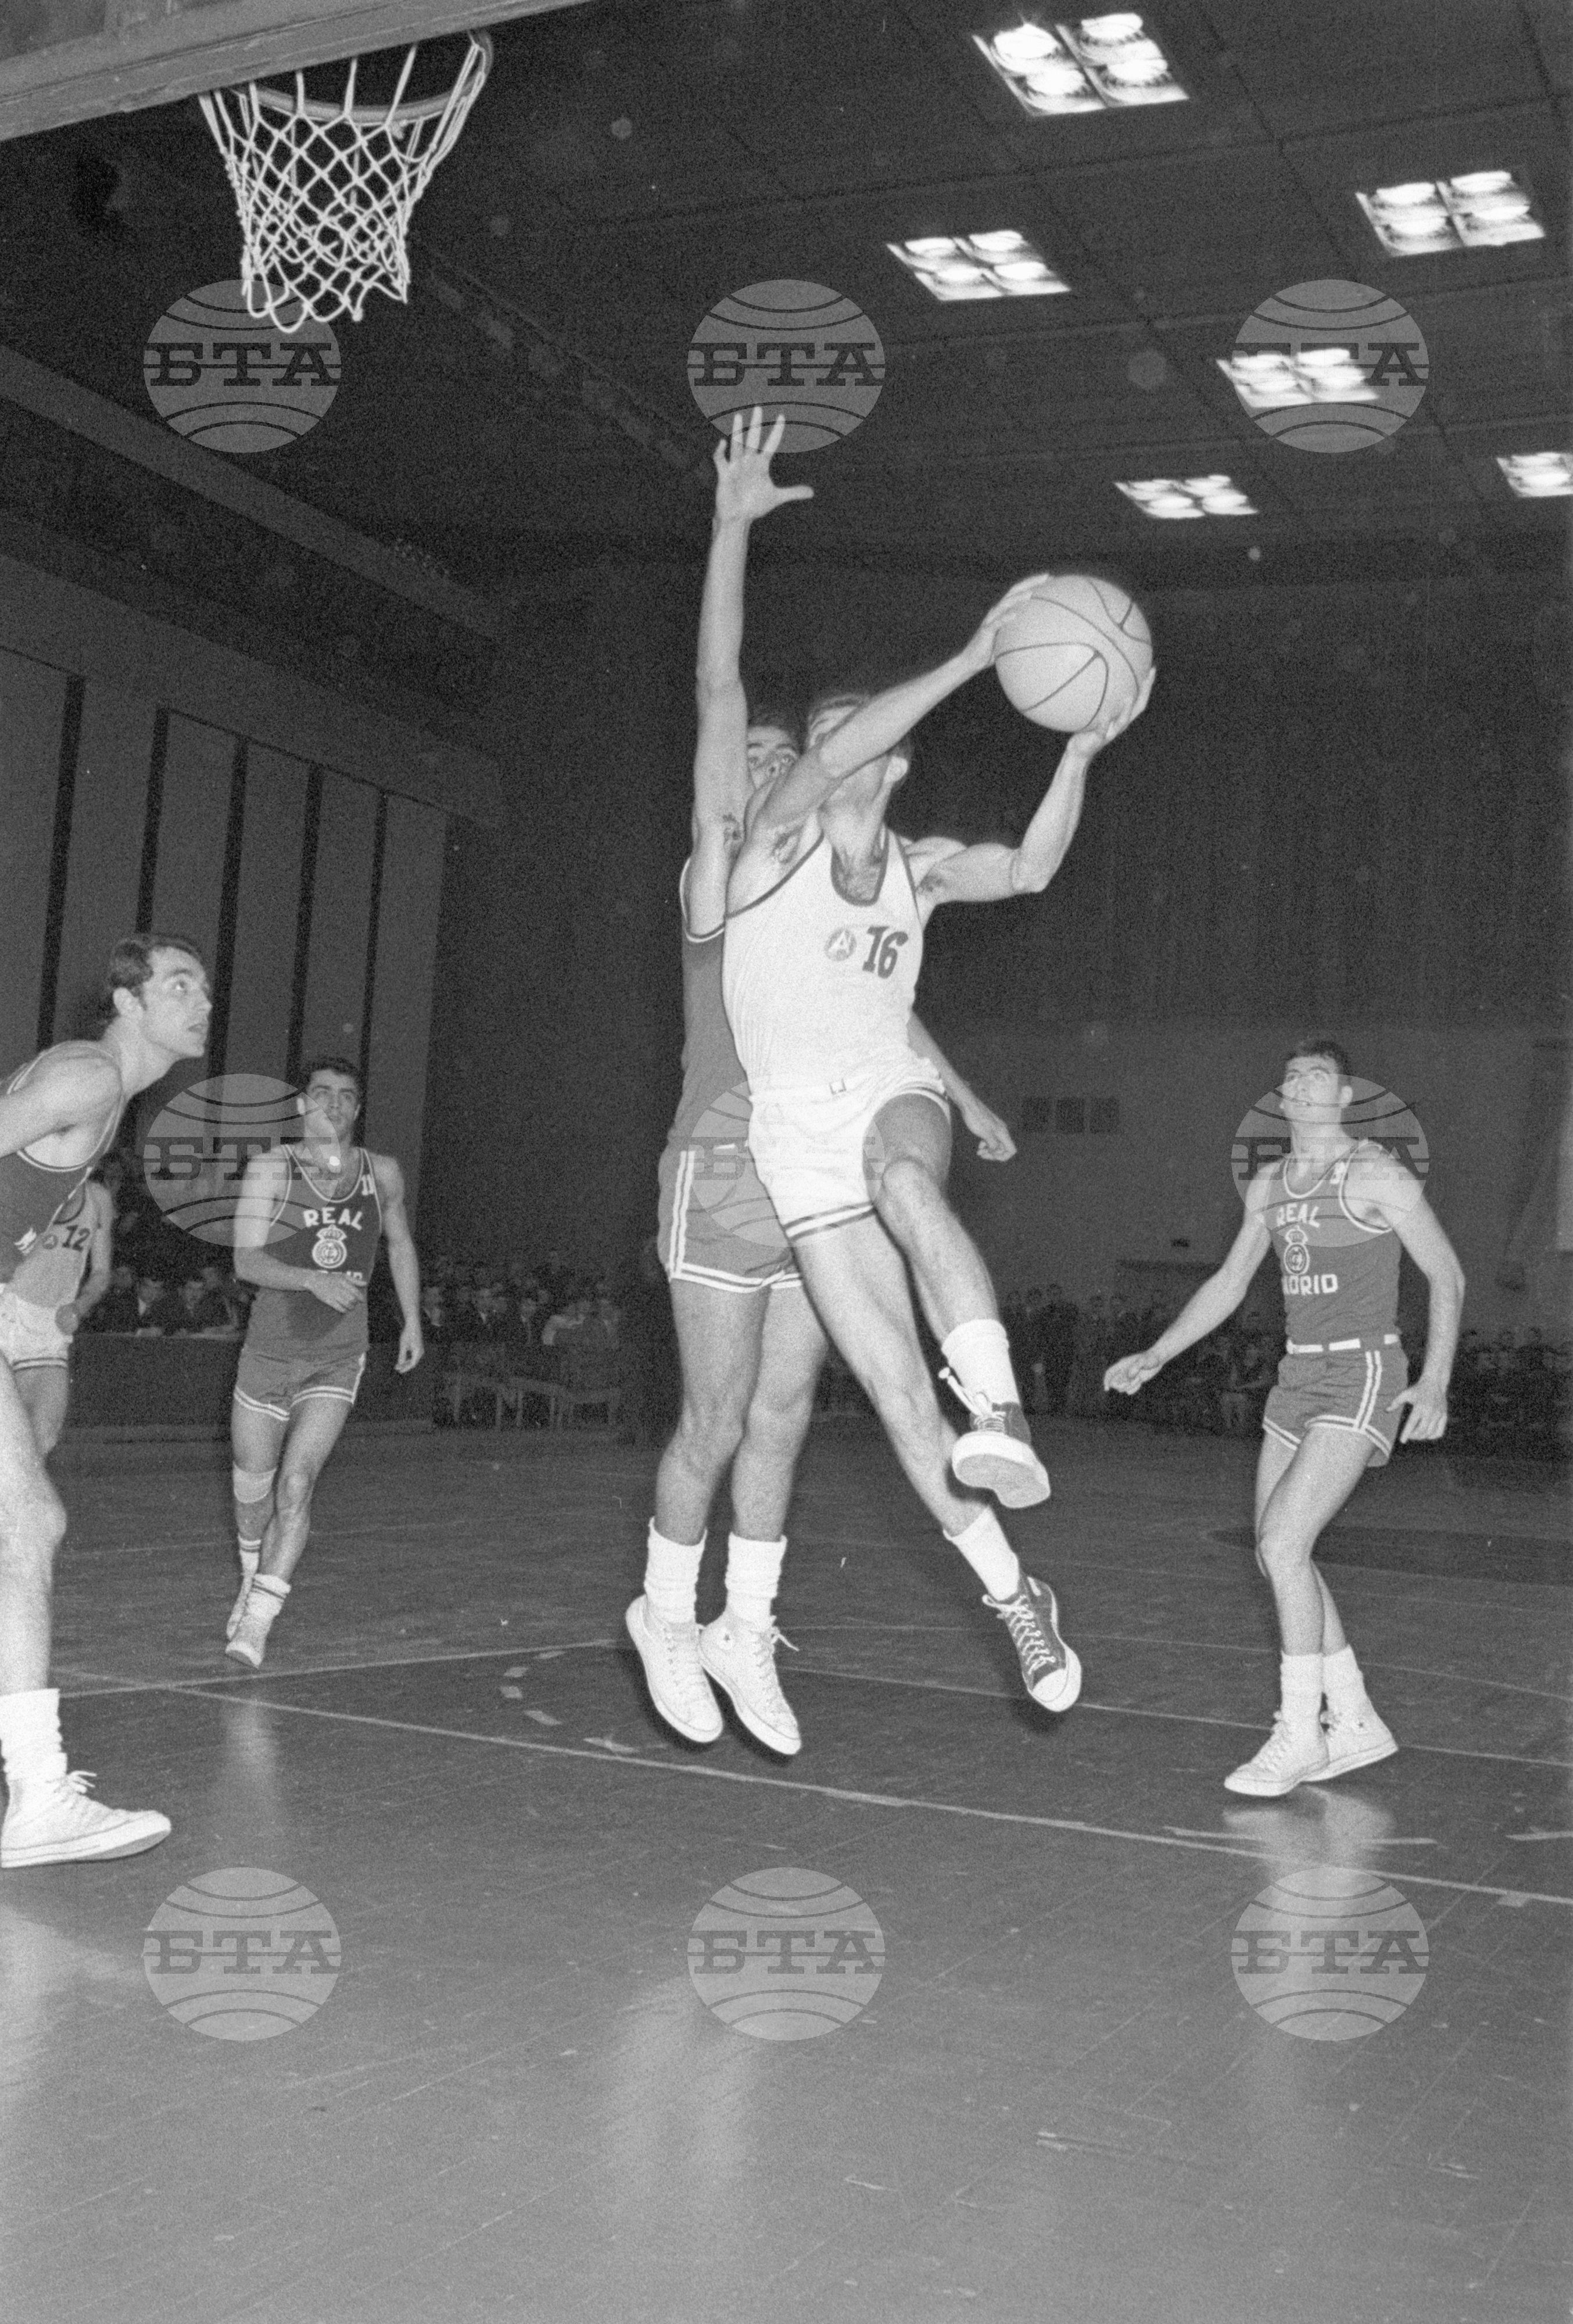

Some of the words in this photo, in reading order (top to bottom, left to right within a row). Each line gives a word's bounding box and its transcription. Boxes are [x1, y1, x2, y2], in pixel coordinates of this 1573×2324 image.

[862, 926, 909, 979] 16
[303, 1206, 363, 1231] REAL
[1276, 1203, 1321, 1229] REAL
[62, 1224, 91, 1253] 12
